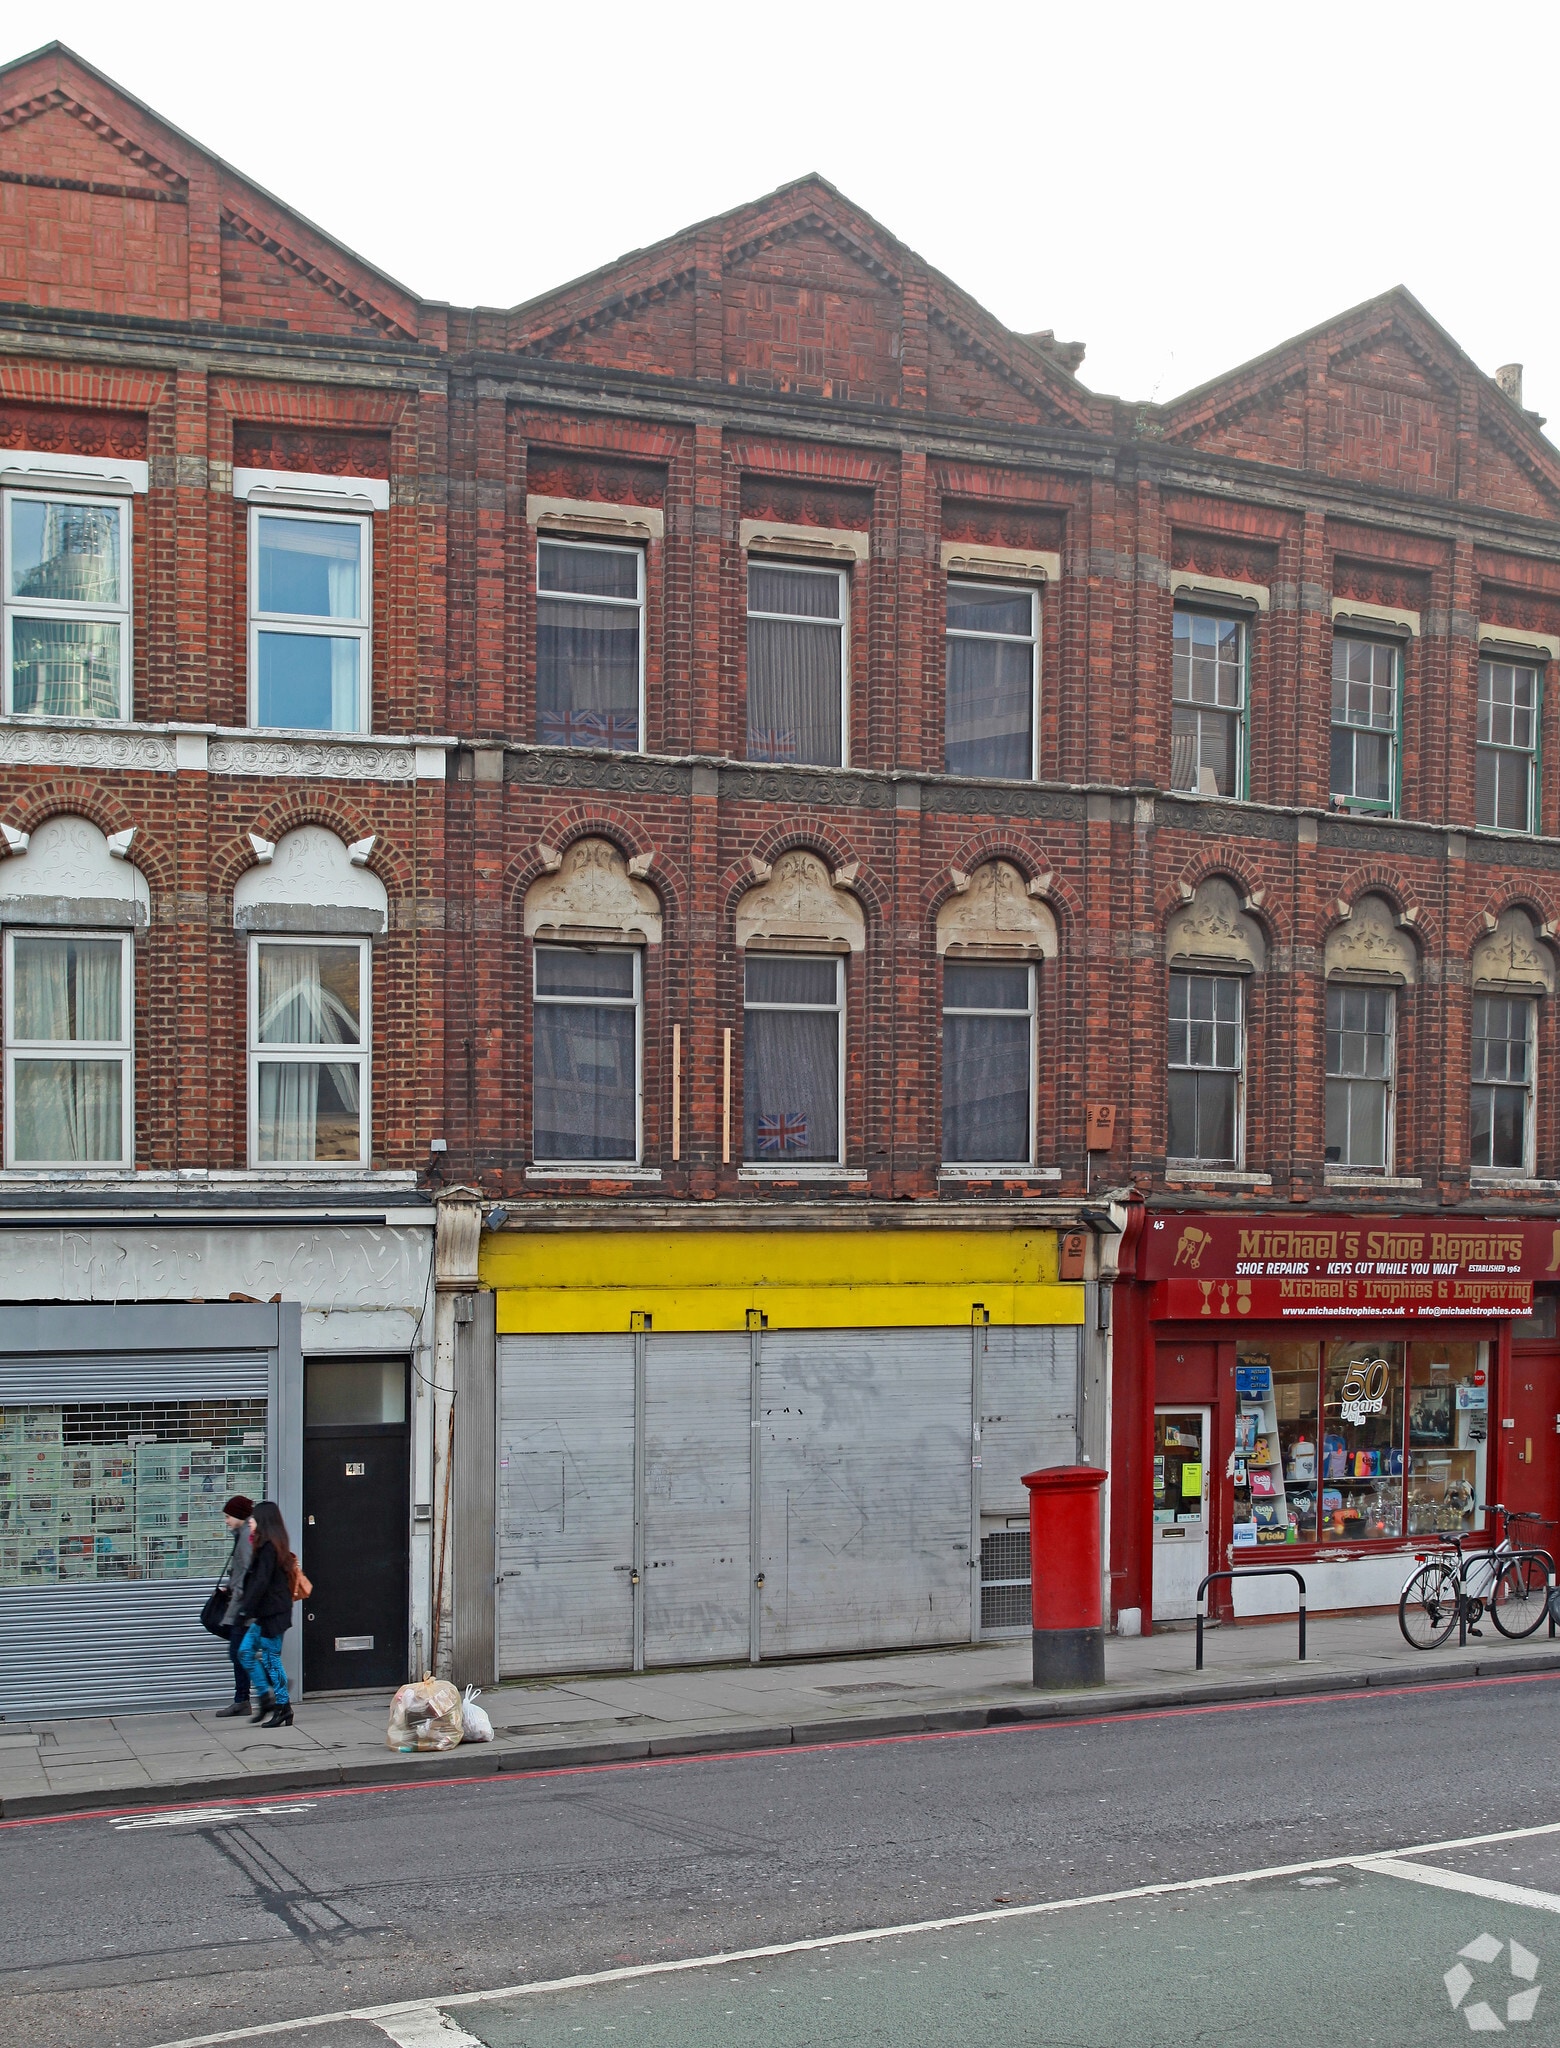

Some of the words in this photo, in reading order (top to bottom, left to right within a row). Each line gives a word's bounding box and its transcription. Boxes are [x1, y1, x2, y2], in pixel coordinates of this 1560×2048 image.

[1153, 1220, 1165, 1230] 45
[1237, 1230, 1361, 1258] Michael's
[1366, 1231, 1425, 1259] Shoe
[1429, 1233, 1524, 1268] Repairs
[1235, 1262, 1264, 1274] SHOE
[1266, 1262, 1309, 1275] REPAIRS
[1327, 1262, 1352, 1275] KEYS
[1355, 1263, 1374, 1275] CUT
[1376, 1263, 1408, 1275] WHILE
[1410, 1263, 1430, 1275] YOU
[1432, 1263, 1458, 1275] WAIT
[1468, 1264, 1506, 1273] ESTABLISHED
[1507, 1265, 1521, 1274] 1962
[1279, 1279, 1359, 1298] Michael's
[1363, 1280, 1434, 1303] Trophies
[1438, 1281, 1448, 1298] &
[1453, 1280, 1533, 1303] Engraving
[1282, 1306, 1406, 1316] www.michaelstrophies.co.uk
[1417, 1306, 1533, 1317] info@michaelstrophies.co.uk
[1176, 1355, 1185, 1363] 45
[1341, 1358, 1390, 1402] 50
[1341, 1399, 1383, 1418] years
[348, 1464, 362, 1474] 41
[1253, 1475, 1271, 1484] Gola
[1293, 1497, 1312, 1507] Gola
[1255, 1505, 1273, 1514] Gola
[1266, 1532, 1285, 1541] Gola
